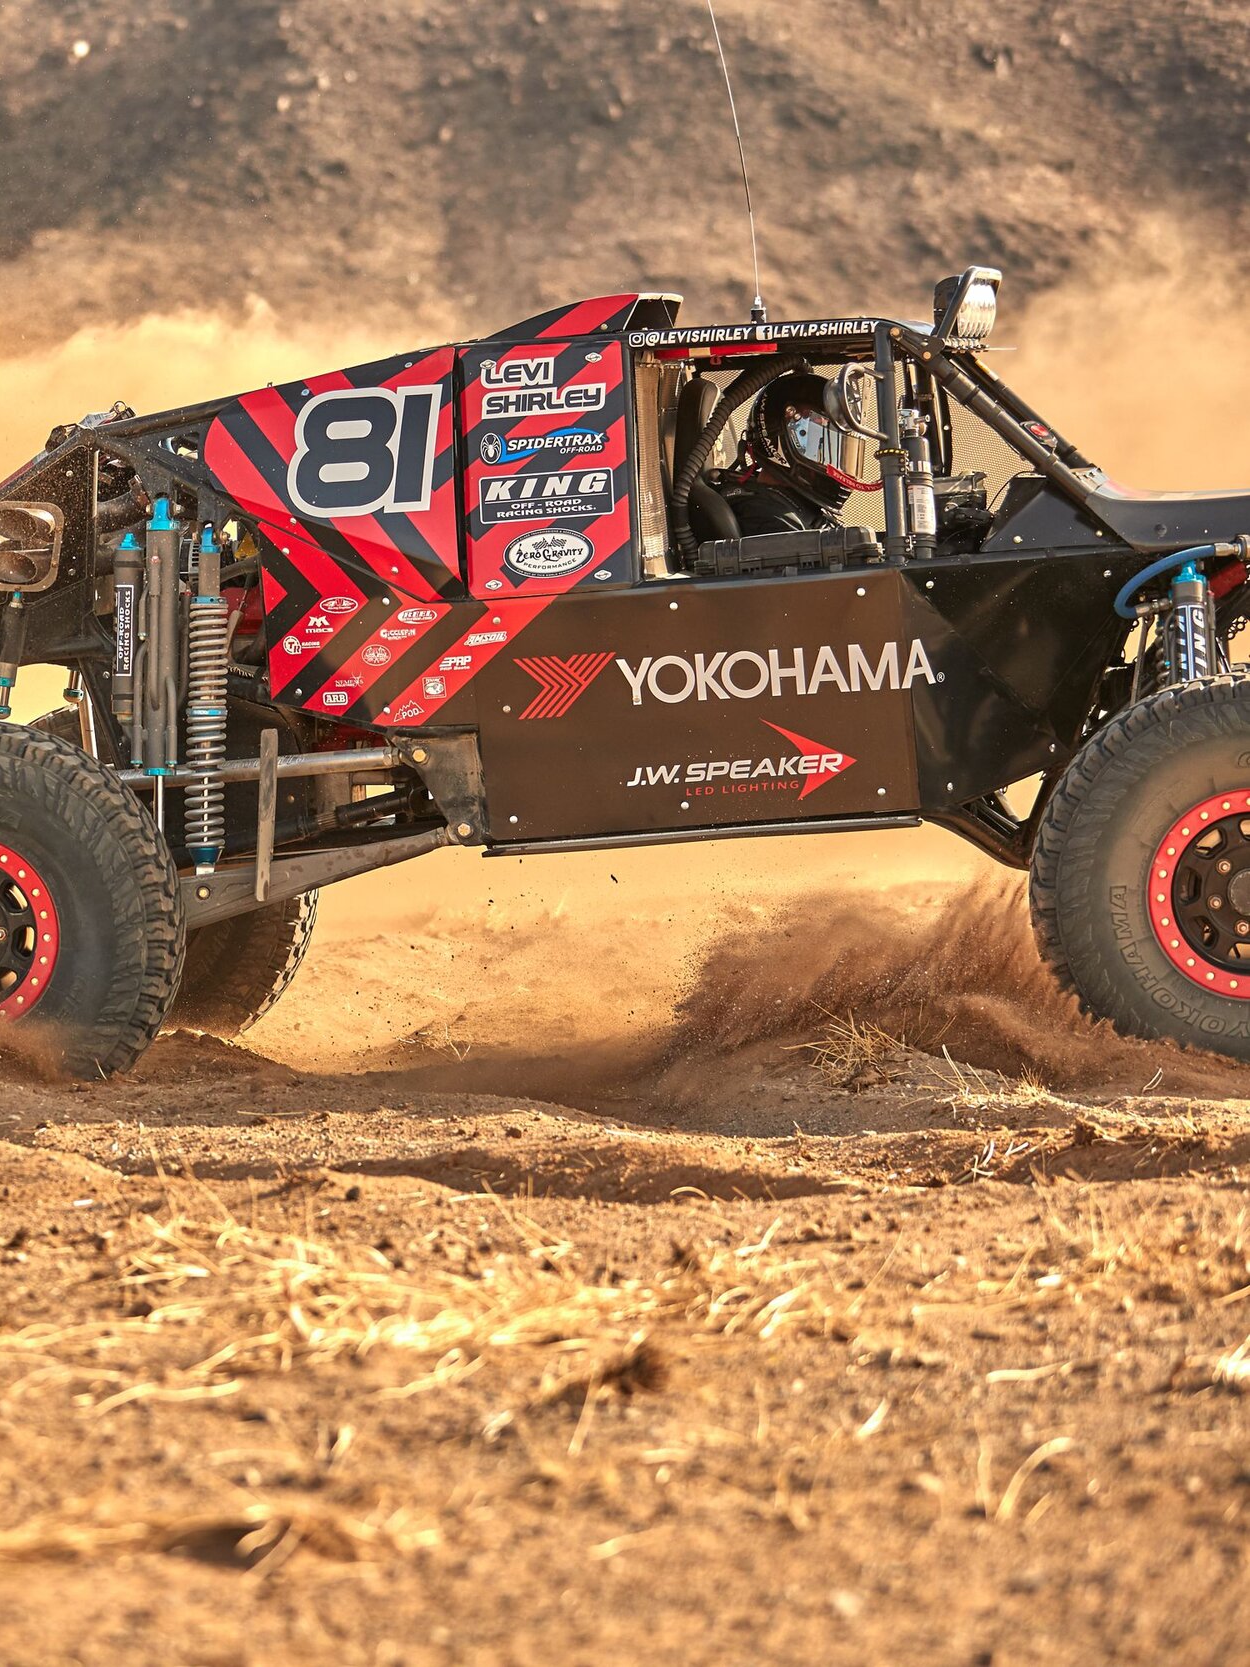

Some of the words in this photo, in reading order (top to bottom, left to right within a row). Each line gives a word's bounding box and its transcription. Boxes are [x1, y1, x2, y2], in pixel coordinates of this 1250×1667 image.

[646, 328, 751, 345] @LEVISHIRLEY
[773, 321, 879, 338] LEVI.P.SHIRLEY
[483, 360, 552, 386] LEVI
[485, 387, 602, 415] SHIRLEY
[507, 433, 604, 451] SPIDERTRAX
[560, 445, 603, 454] OFF-ROAD
[288, 385, 442, 517] 81
[485, 472, 608, 501] KING
[545, 499, 582, 508] ROAD
[497, 508, 543, 518] RACING
[523, 557, 577, 570] PERFORMANCE
[465, 631, 507, 646] AMSOIL
[445, 656, 472, 667] PRP
[326, 694, 346, 703] ARB
[401, 708, 419, 719] POD
[627, 764, 679, 786] J.W.
[685, 753, 844, 782] SPEAKER
[687, 785, 717, 796] LED
[722, 780, 799, 795] LIGHTING
